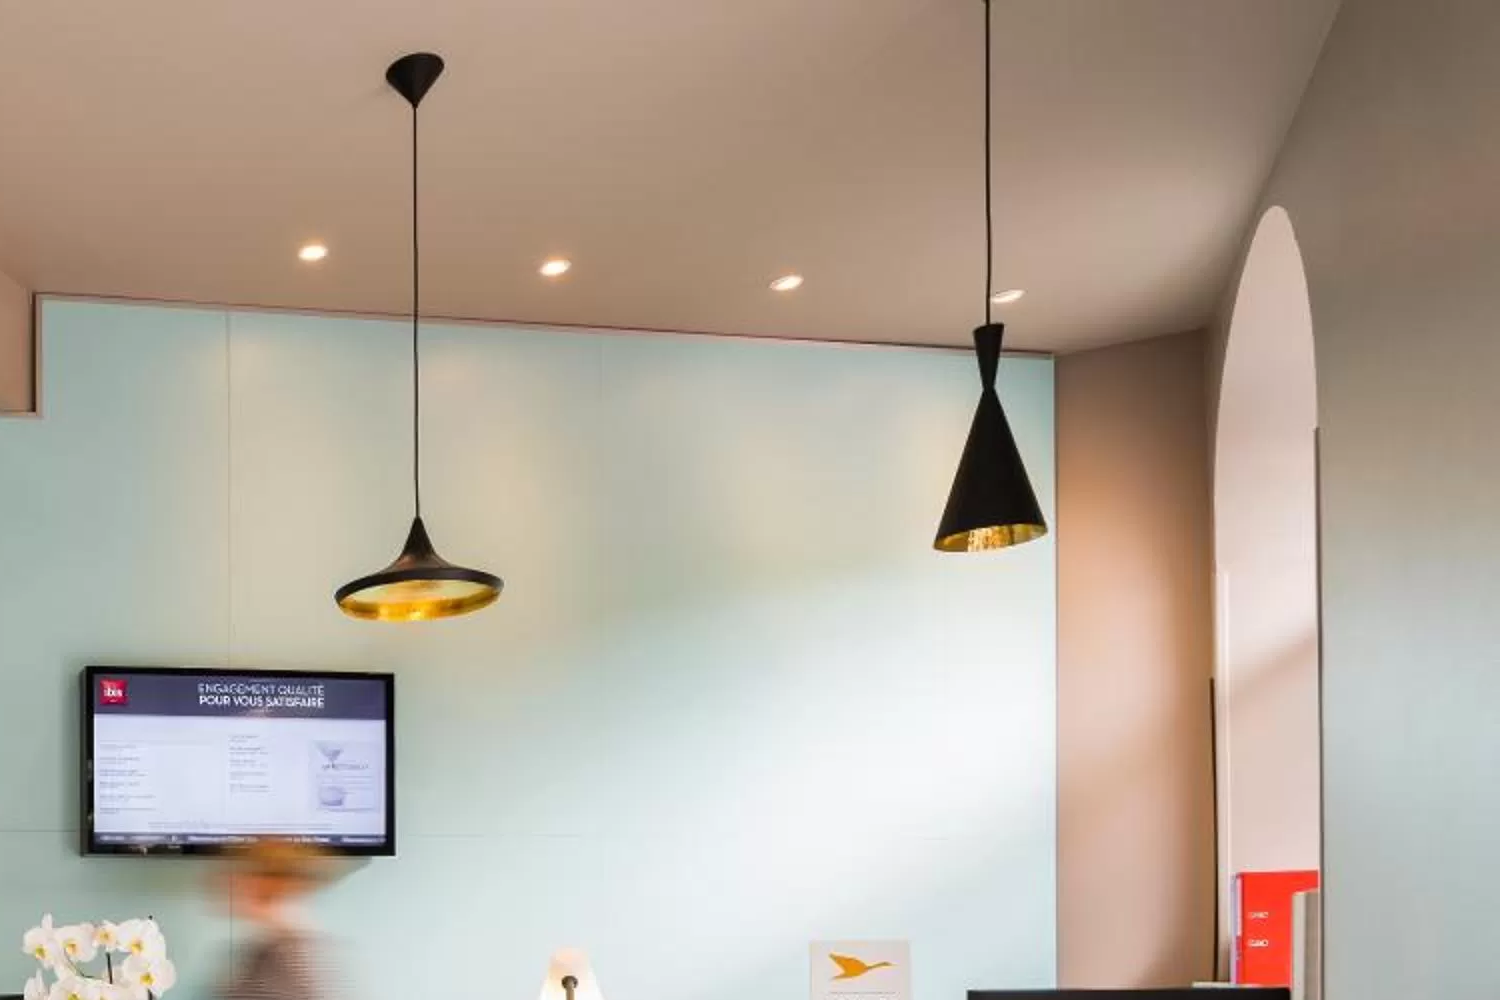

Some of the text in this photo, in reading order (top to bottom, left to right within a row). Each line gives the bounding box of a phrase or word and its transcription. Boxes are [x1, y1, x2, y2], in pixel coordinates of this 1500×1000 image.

[197, 683, 276, 695] ENGAGEMENT
[199, 695, 325, 709] POUR VOUS SATISFAIRE
